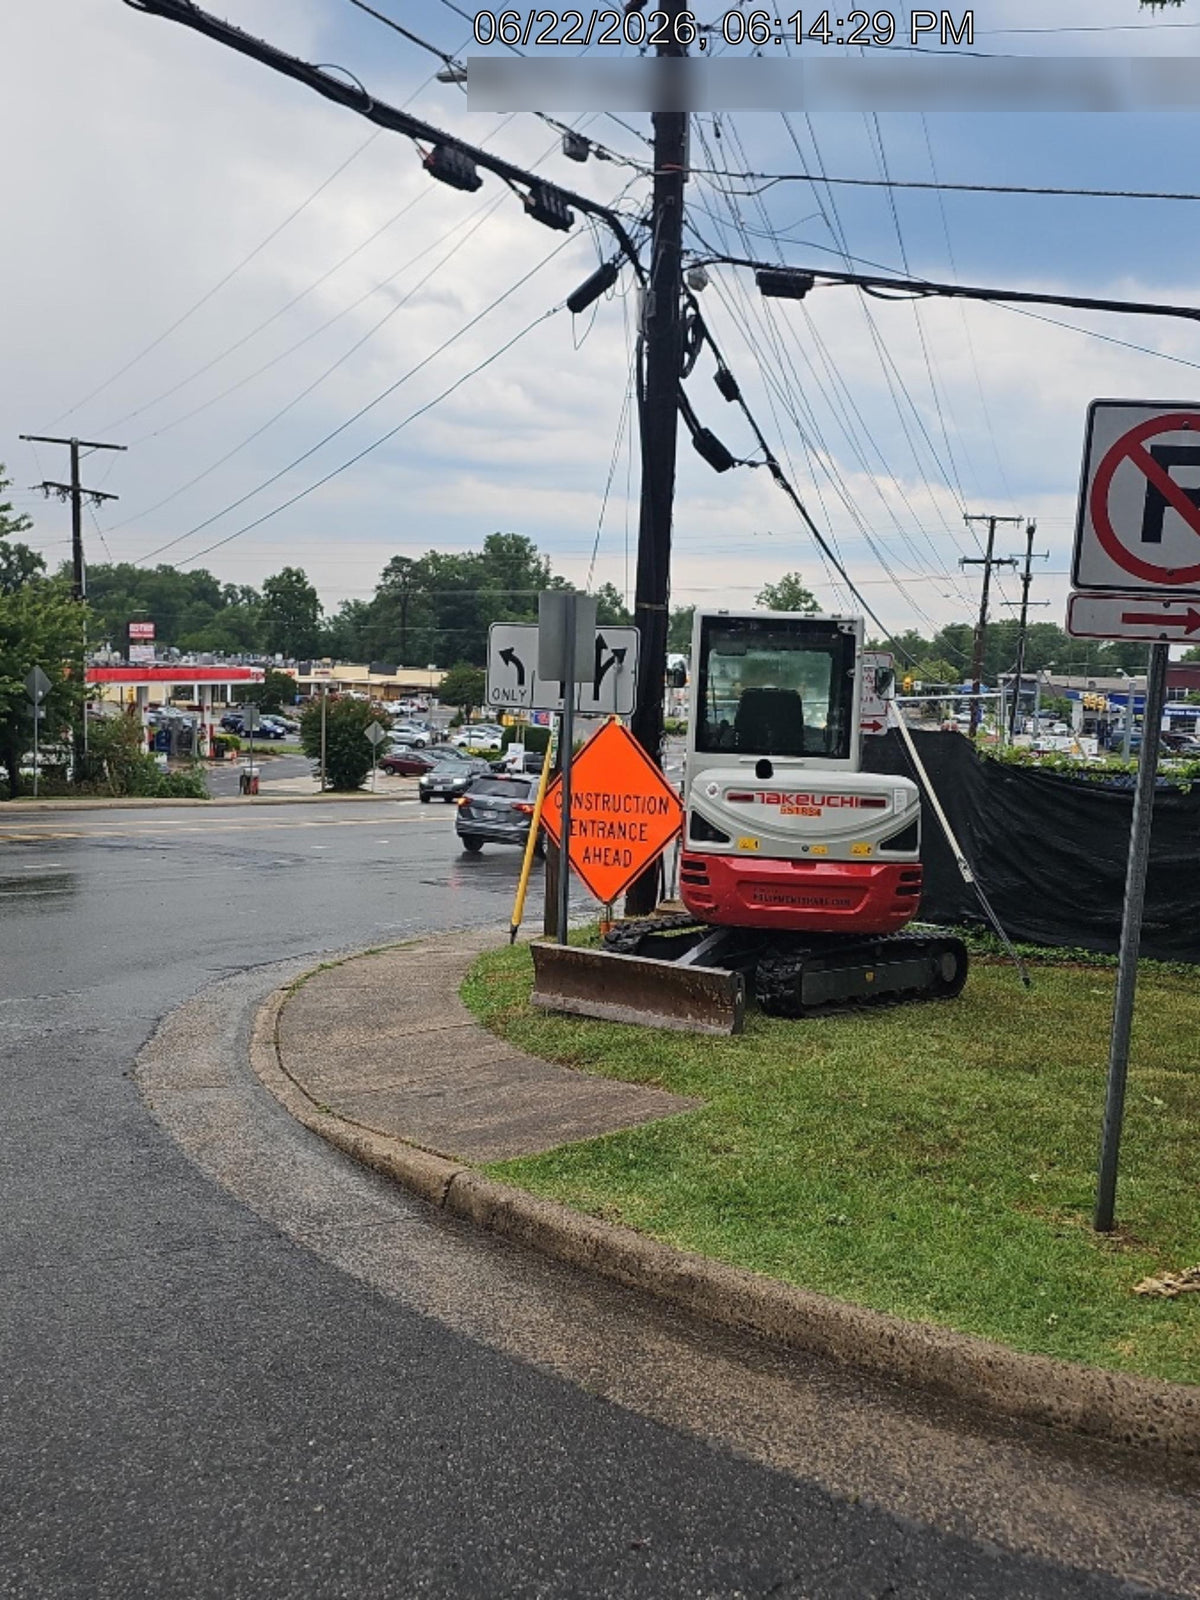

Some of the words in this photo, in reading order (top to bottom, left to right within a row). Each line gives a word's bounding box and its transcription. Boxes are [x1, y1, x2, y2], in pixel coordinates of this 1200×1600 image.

[491, 687, 528, 704] ONLY
[554, 790, 670, 816] CNSTRUCTION
[569, 819, 648, 842] ENTRANCE
[582, 845, 632, 868] AHEAD
